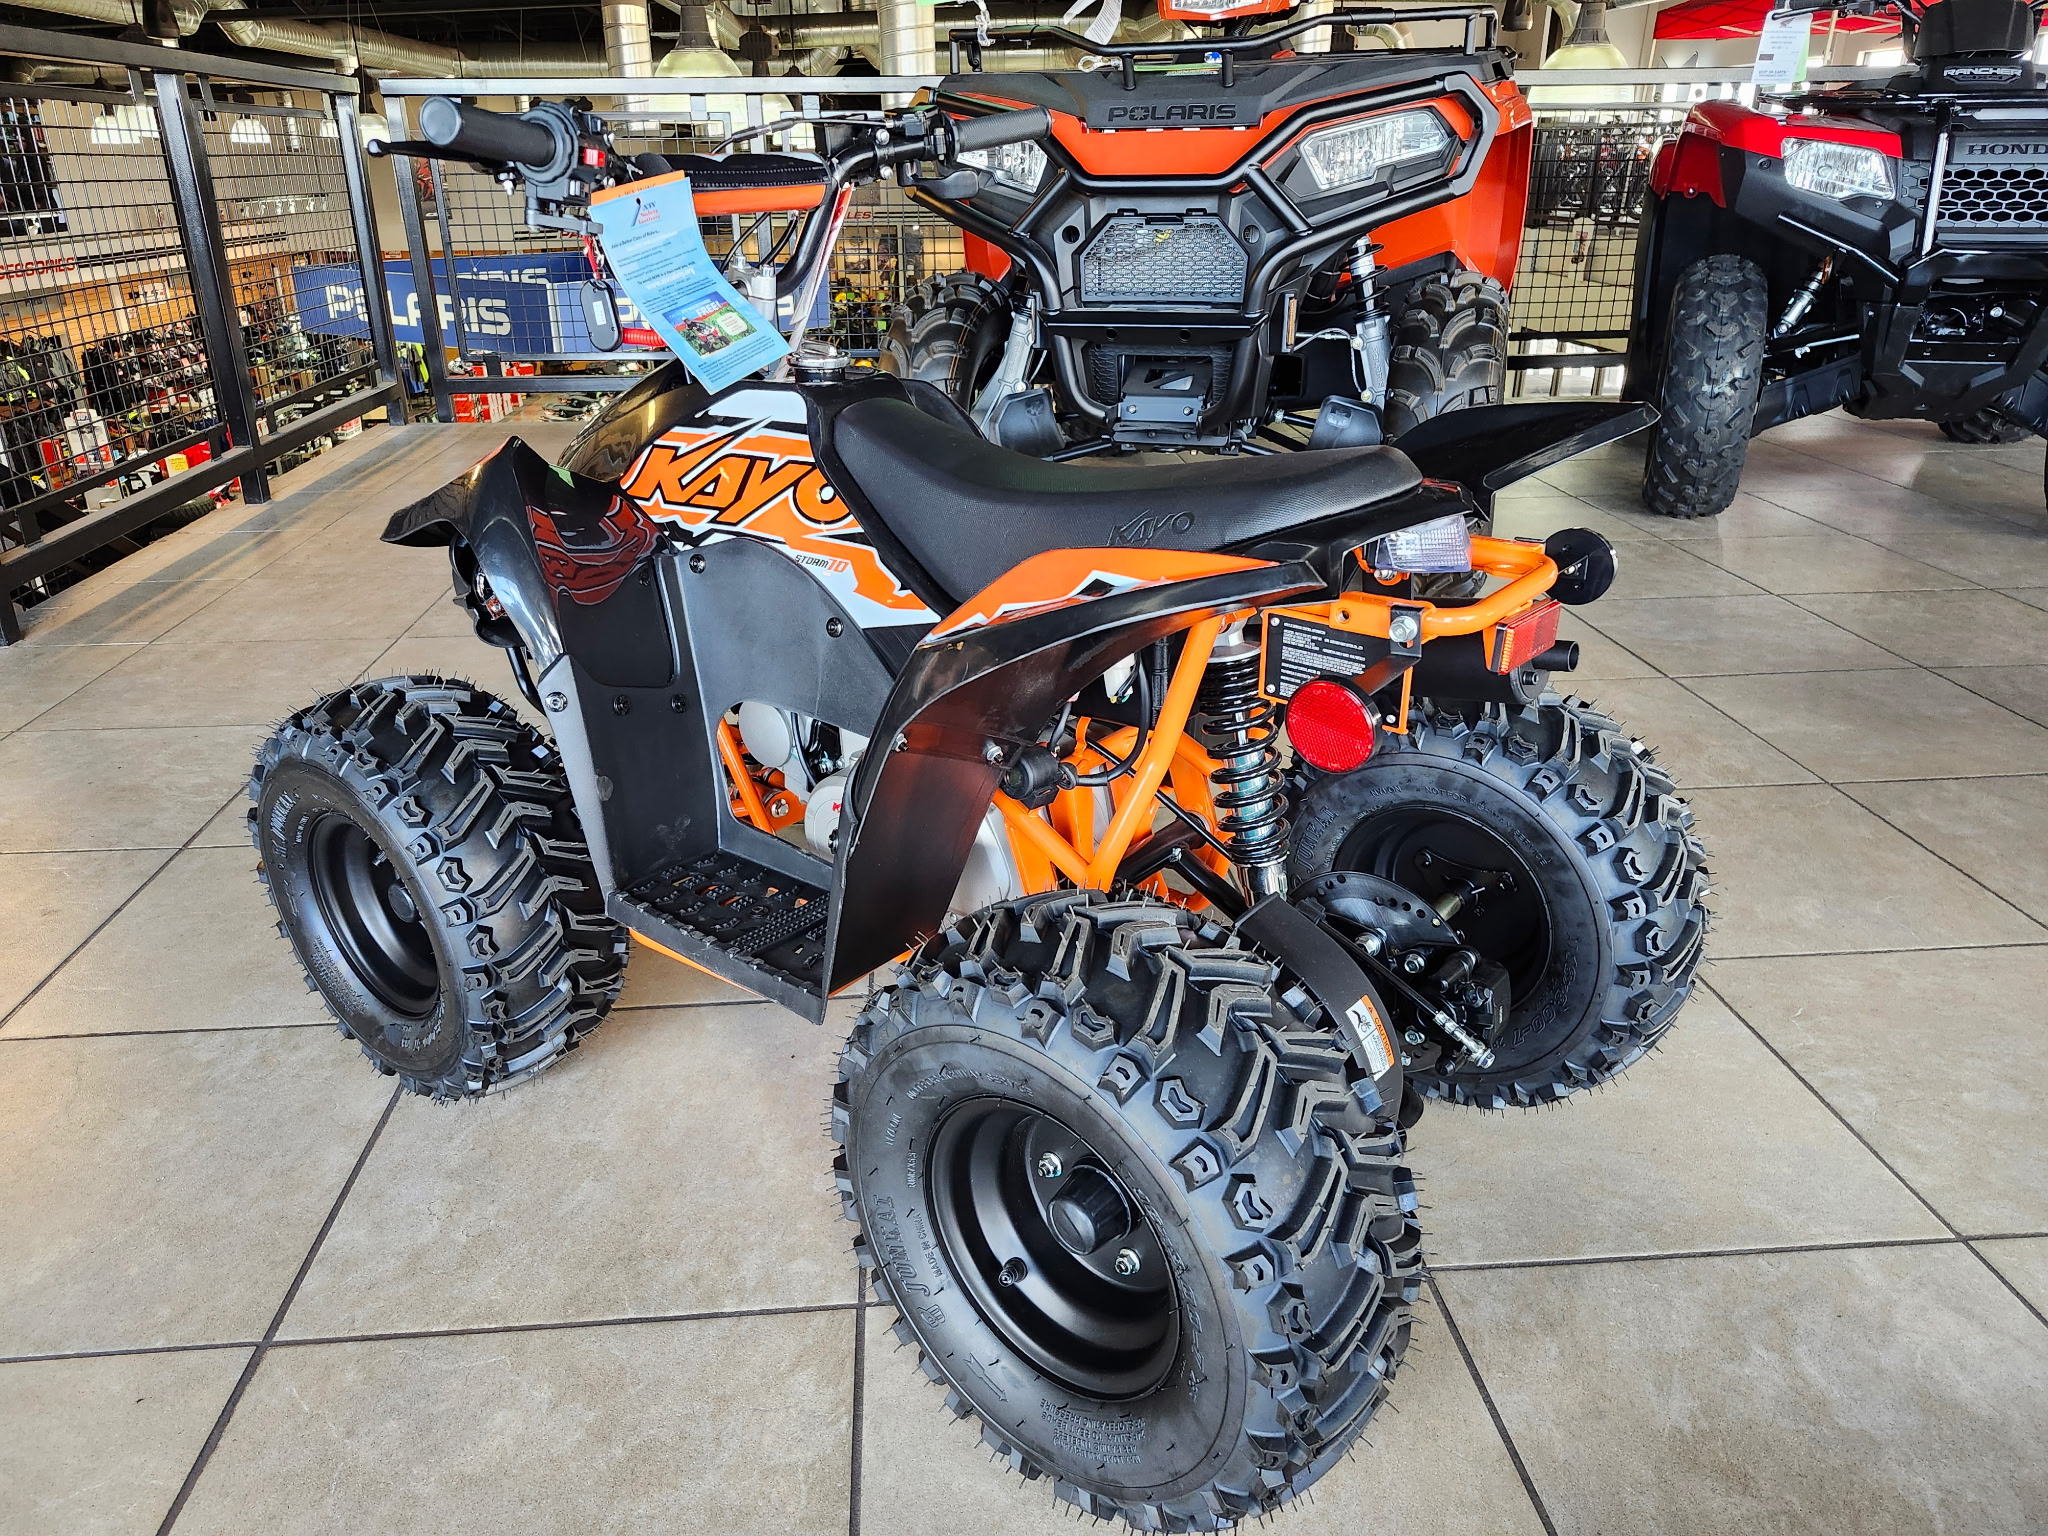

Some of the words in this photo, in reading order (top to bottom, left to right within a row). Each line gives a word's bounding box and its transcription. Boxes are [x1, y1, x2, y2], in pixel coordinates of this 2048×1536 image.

[1943, 67, 2022, 76] RANCHER
[1108, 104, 1236, 121] POLARIS
[1966, 143, 2048, 155] HOND
[696, 300, 722, 318] FREE!
[627, 443, 851, 526] KAYO
[1374, 1017, 1392, 1057] CAUTION
[913, 1212, 927, 1240] CHINA
[924, 1251, 943, 1278] MADE
